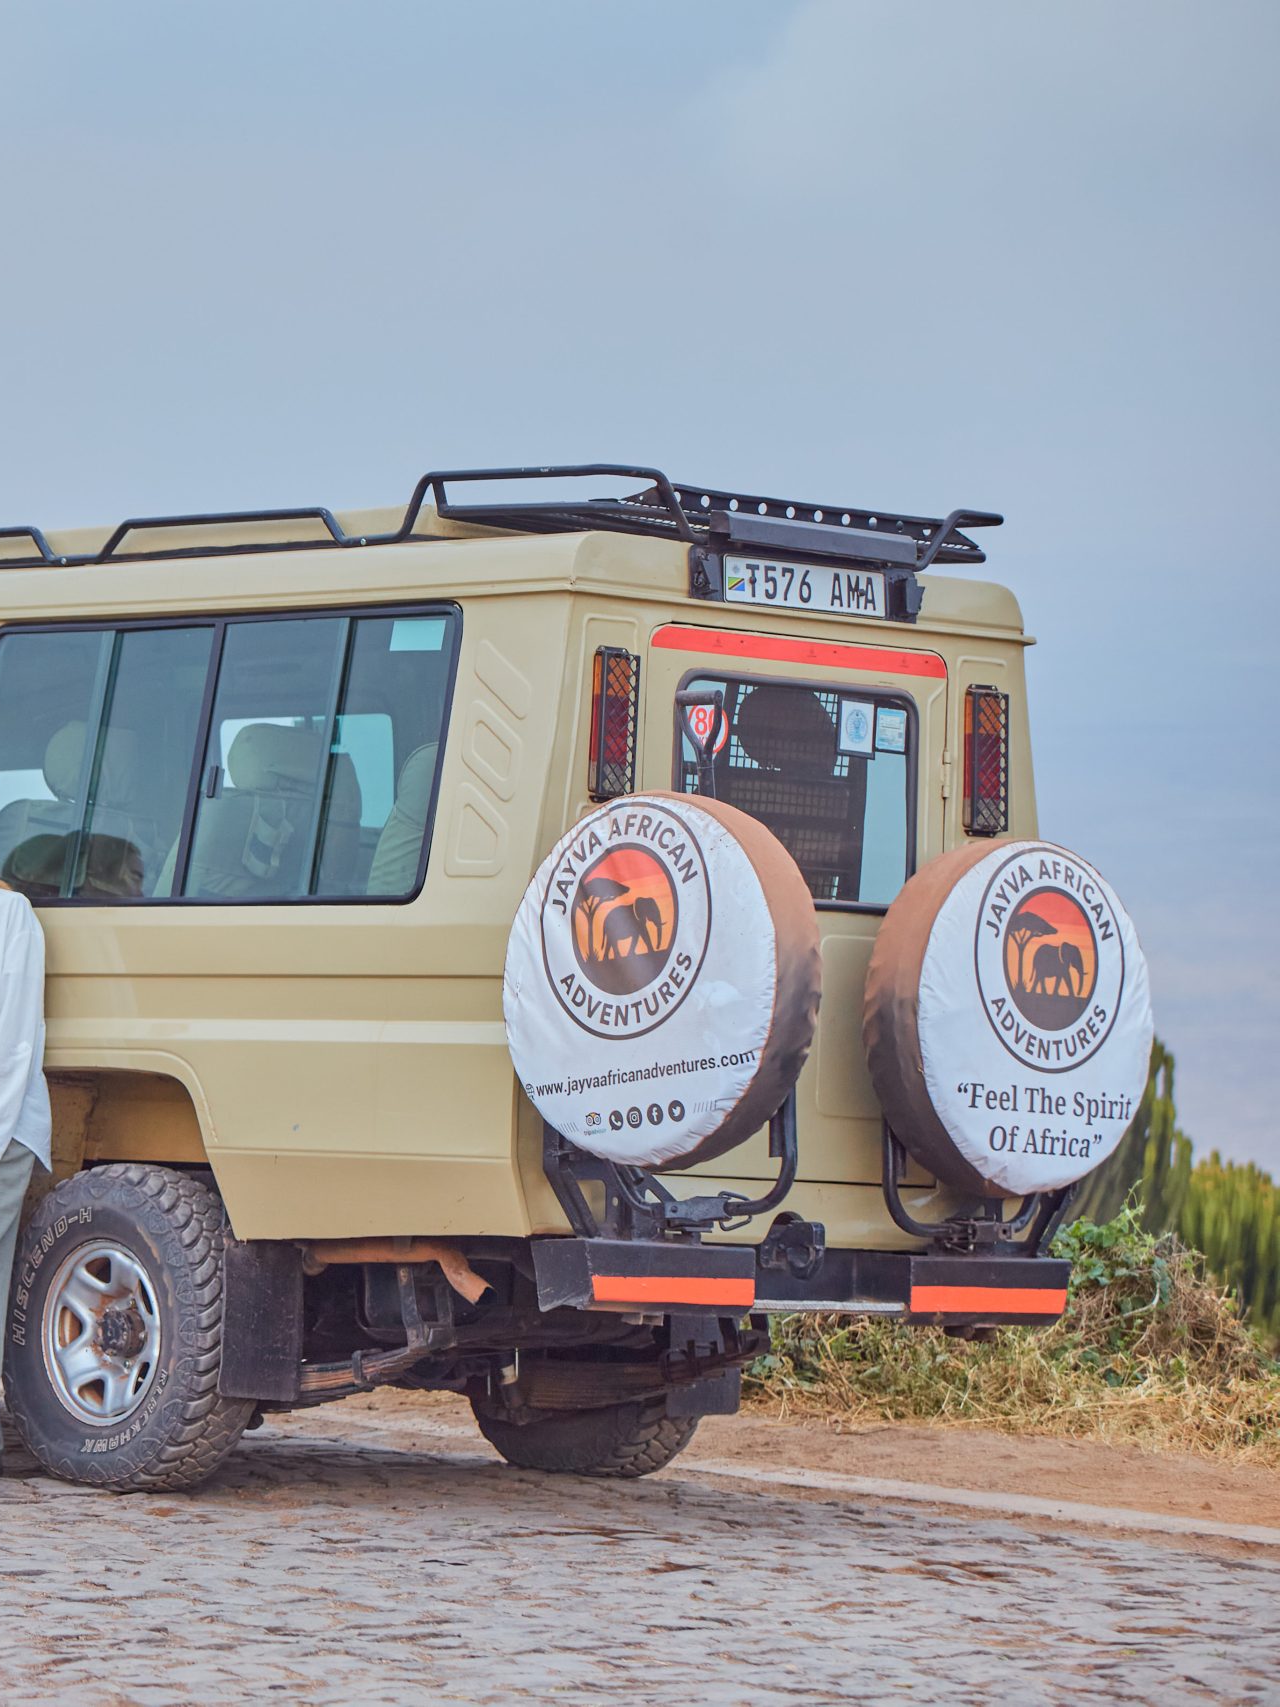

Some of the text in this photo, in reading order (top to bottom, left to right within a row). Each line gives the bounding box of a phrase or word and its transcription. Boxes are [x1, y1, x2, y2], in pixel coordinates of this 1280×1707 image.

[746, 563, 876, 611] T576 AMA
[552, 813, 699, 915] JAYVA AFRICAN
[985, 859, 1114, 942] JAYVA AFRICAN
[560, 950, 693, 1027] ADVENTURES
[991, 997, 1108, 1061] ADVENTURES
[536, 1050, 756, 1097] www.jayvaafricanadventures.com
[1024, 1087, 1066, 1115] The
[1073, 1091, 1132, 1126] Spirit
[989, 1125, 1019, 1152] Of
